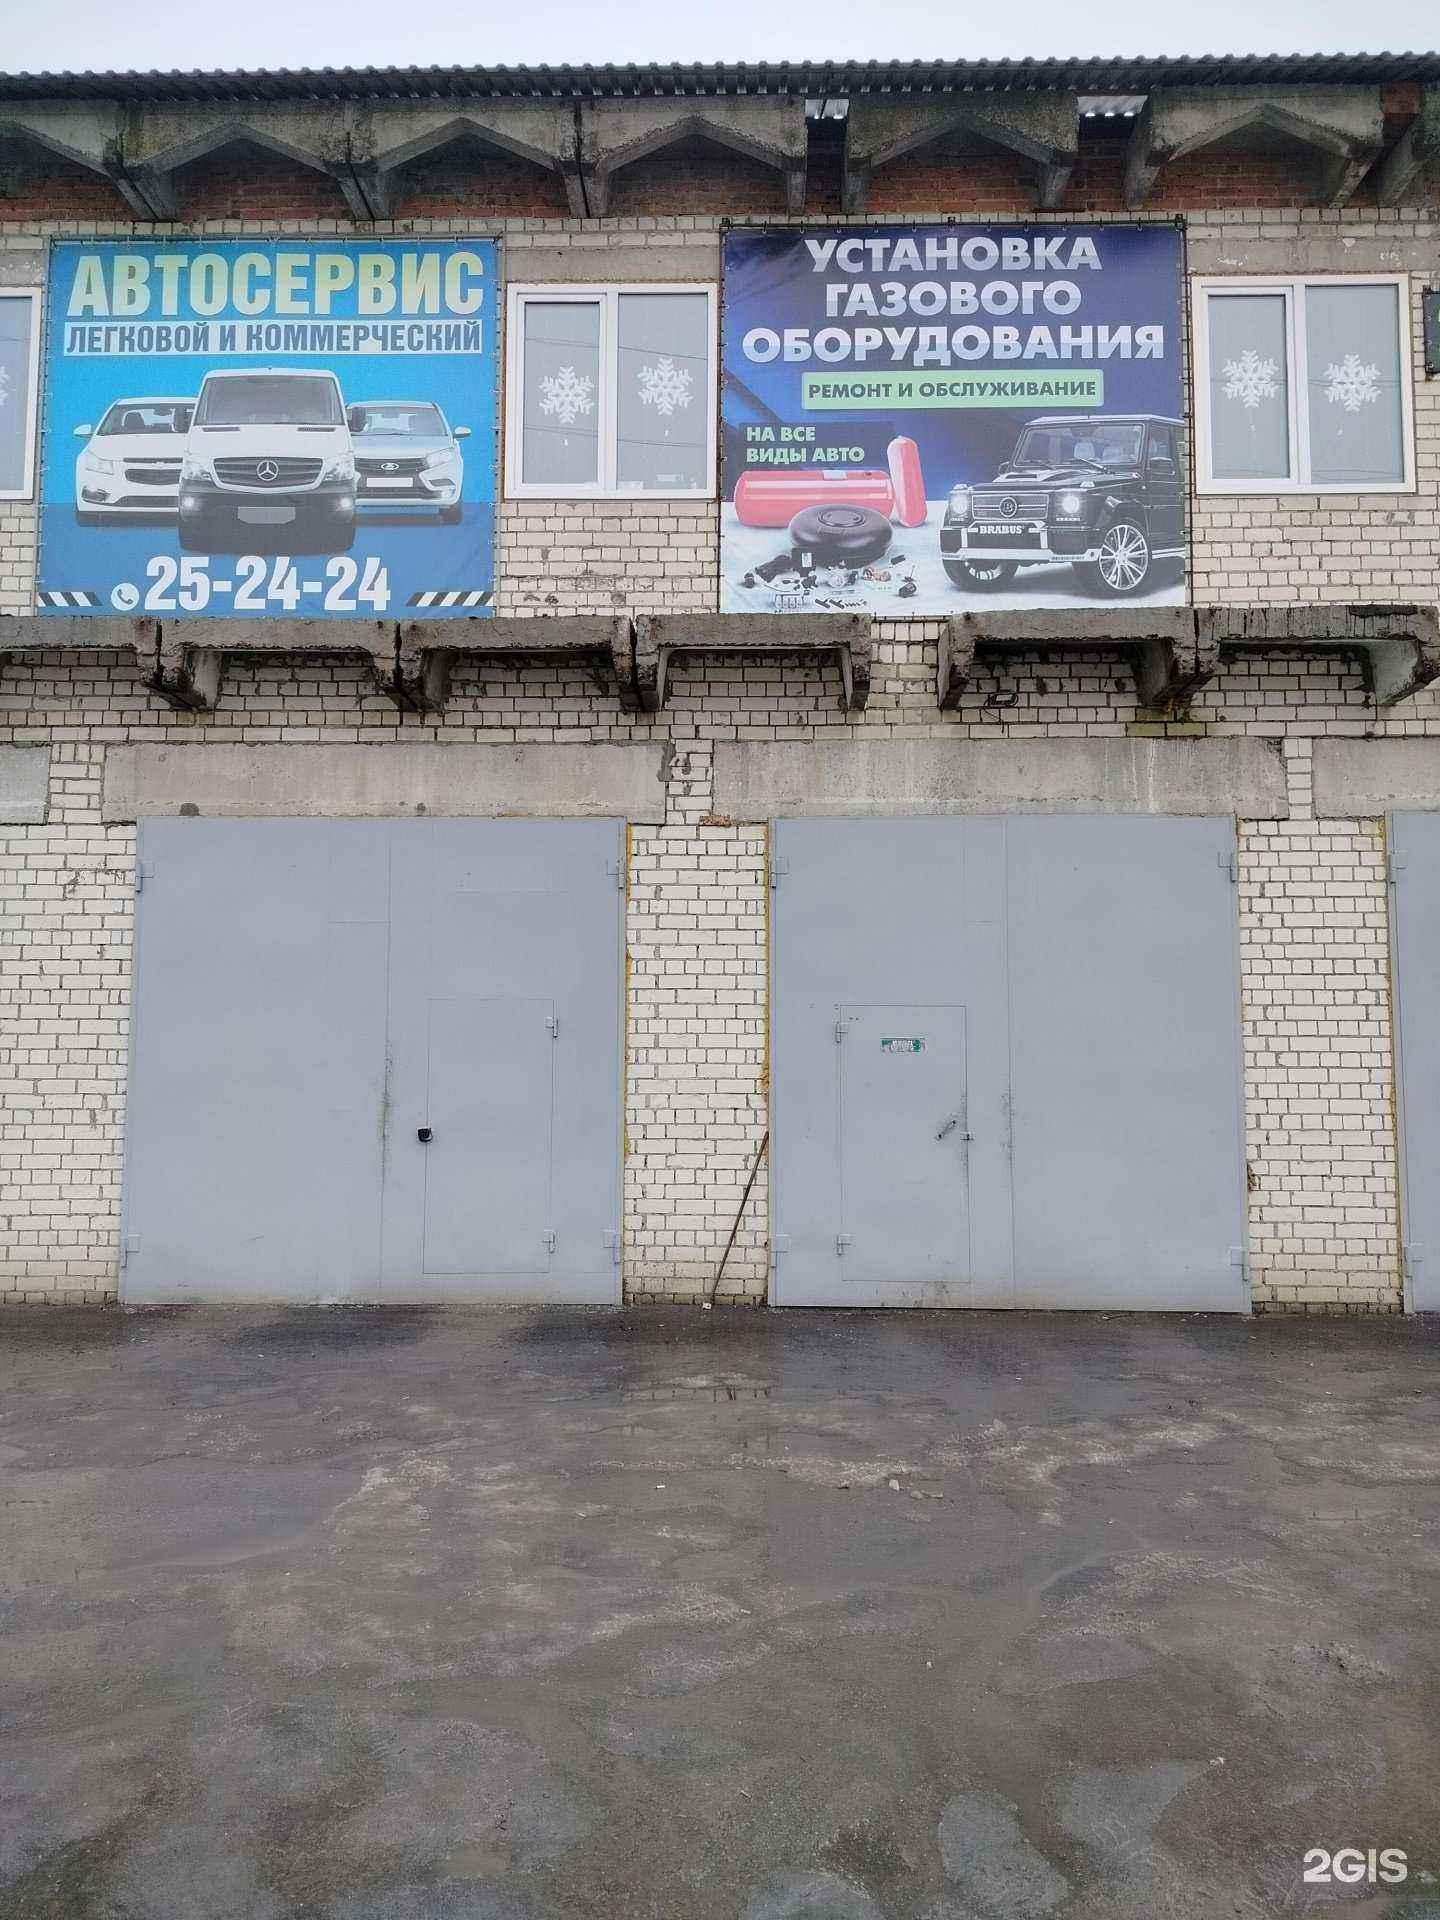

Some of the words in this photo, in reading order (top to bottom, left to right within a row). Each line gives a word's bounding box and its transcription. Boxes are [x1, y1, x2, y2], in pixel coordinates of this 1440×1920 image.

[805, 236, 1102, 273] УСТАНОВКА
[67, 251, 483, 317] АВТОСЕРВИС
[826, 280, 1082, 317] ГАЗОВОГО
[66, 321, 210, 353] ЛЕГКОВОЙ
[215, 327, 236, 352] И
[246, 320, 481, 352] КОММЕРЧЕСКИЙ
[742, 325, 1164, 367] ОБОРУДОВАНИЯ
[808, 382, 892, 399] РЕМОНТ
[897, 382, 913, 398] И
[918, 380, 1096, 398] ОБСЛУЖИВАНИЕ
[746, 426, 776, 442] НА
[780, 426, 816, 442] ВСЕ
[746, 447, 807, 465] ВИДЫ
[811, 447, 865, 463] АВТО
[979, 525, 1022, 534] BRABUS
[144, 555, 391, 611] 25-24-24
